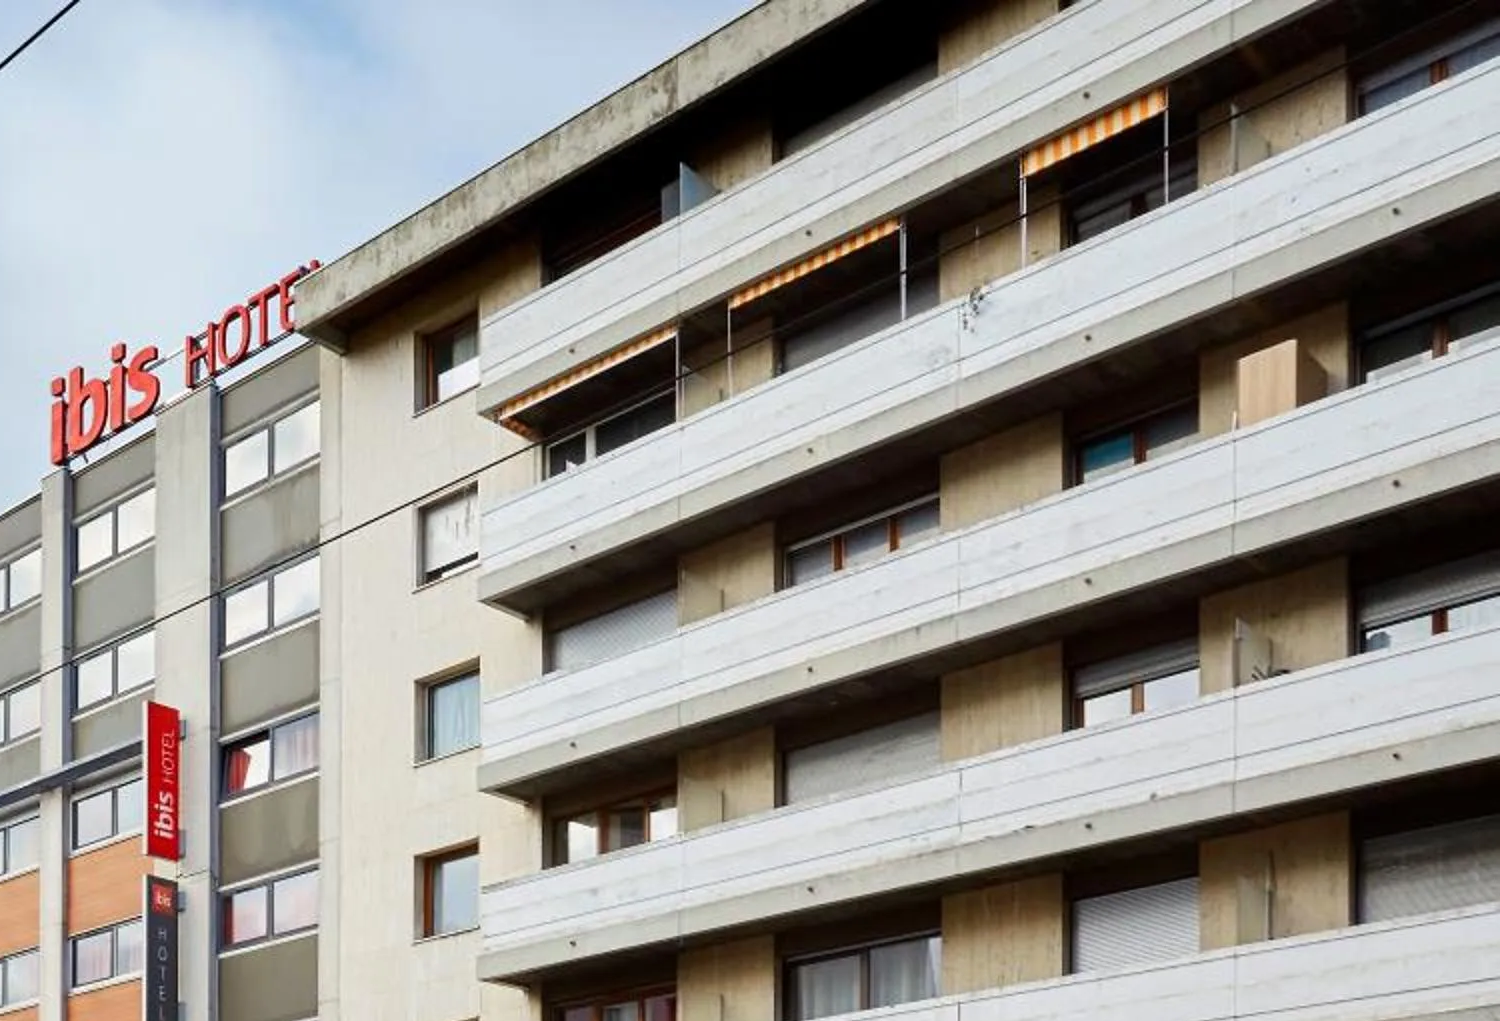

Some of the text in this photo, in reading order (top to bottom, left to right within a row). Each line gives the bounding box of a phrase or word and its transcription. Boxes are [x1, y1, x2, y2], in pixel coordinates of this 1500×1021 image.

[51, 260, 321, 465] ibis HOTE
[154, 729, 175, 839] ibis HOTEL
[156, 927, 169, 1021] HOTEL
